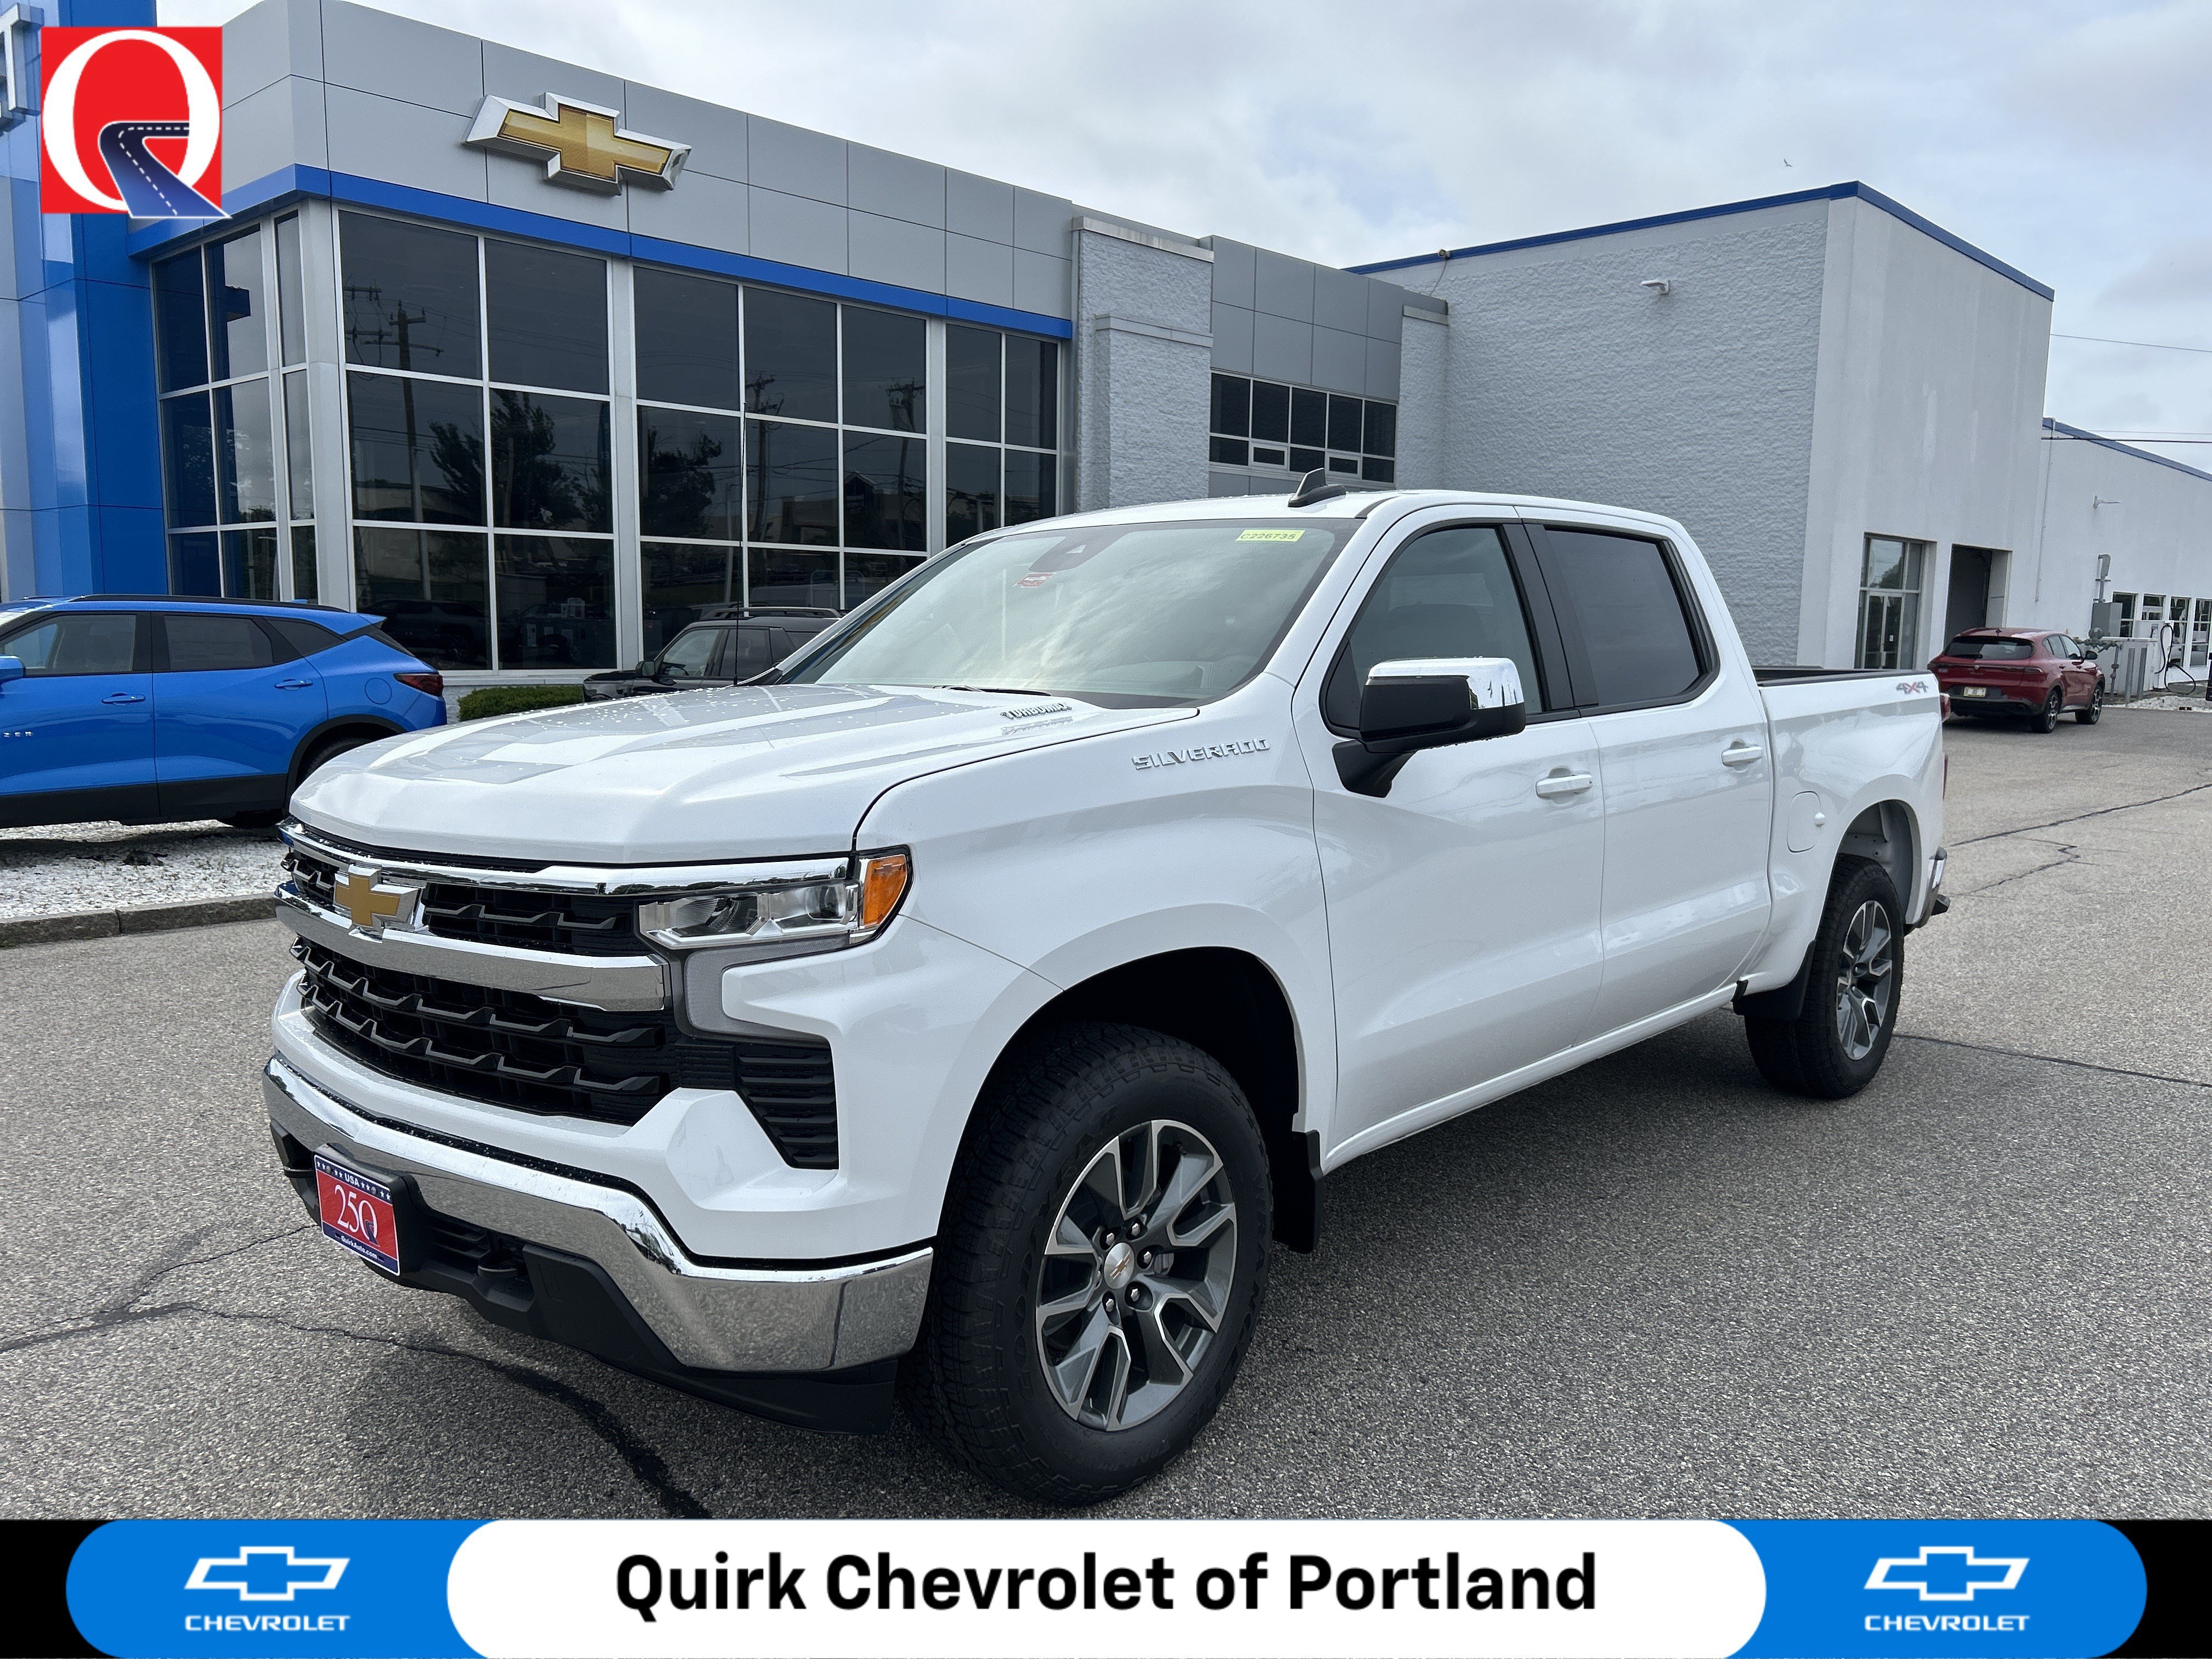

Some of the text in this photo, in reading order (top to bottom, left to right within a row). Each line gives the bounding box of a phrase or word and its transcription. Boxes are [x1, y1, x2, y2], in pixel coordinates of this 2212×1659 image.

[1239, 532, 1297, 540] C226735
[999, 702, 1073, 720] TURBOMAX
[1131, 737, 1272, 770] SILVERADO
[344, 1172, 360, 1188] USA
